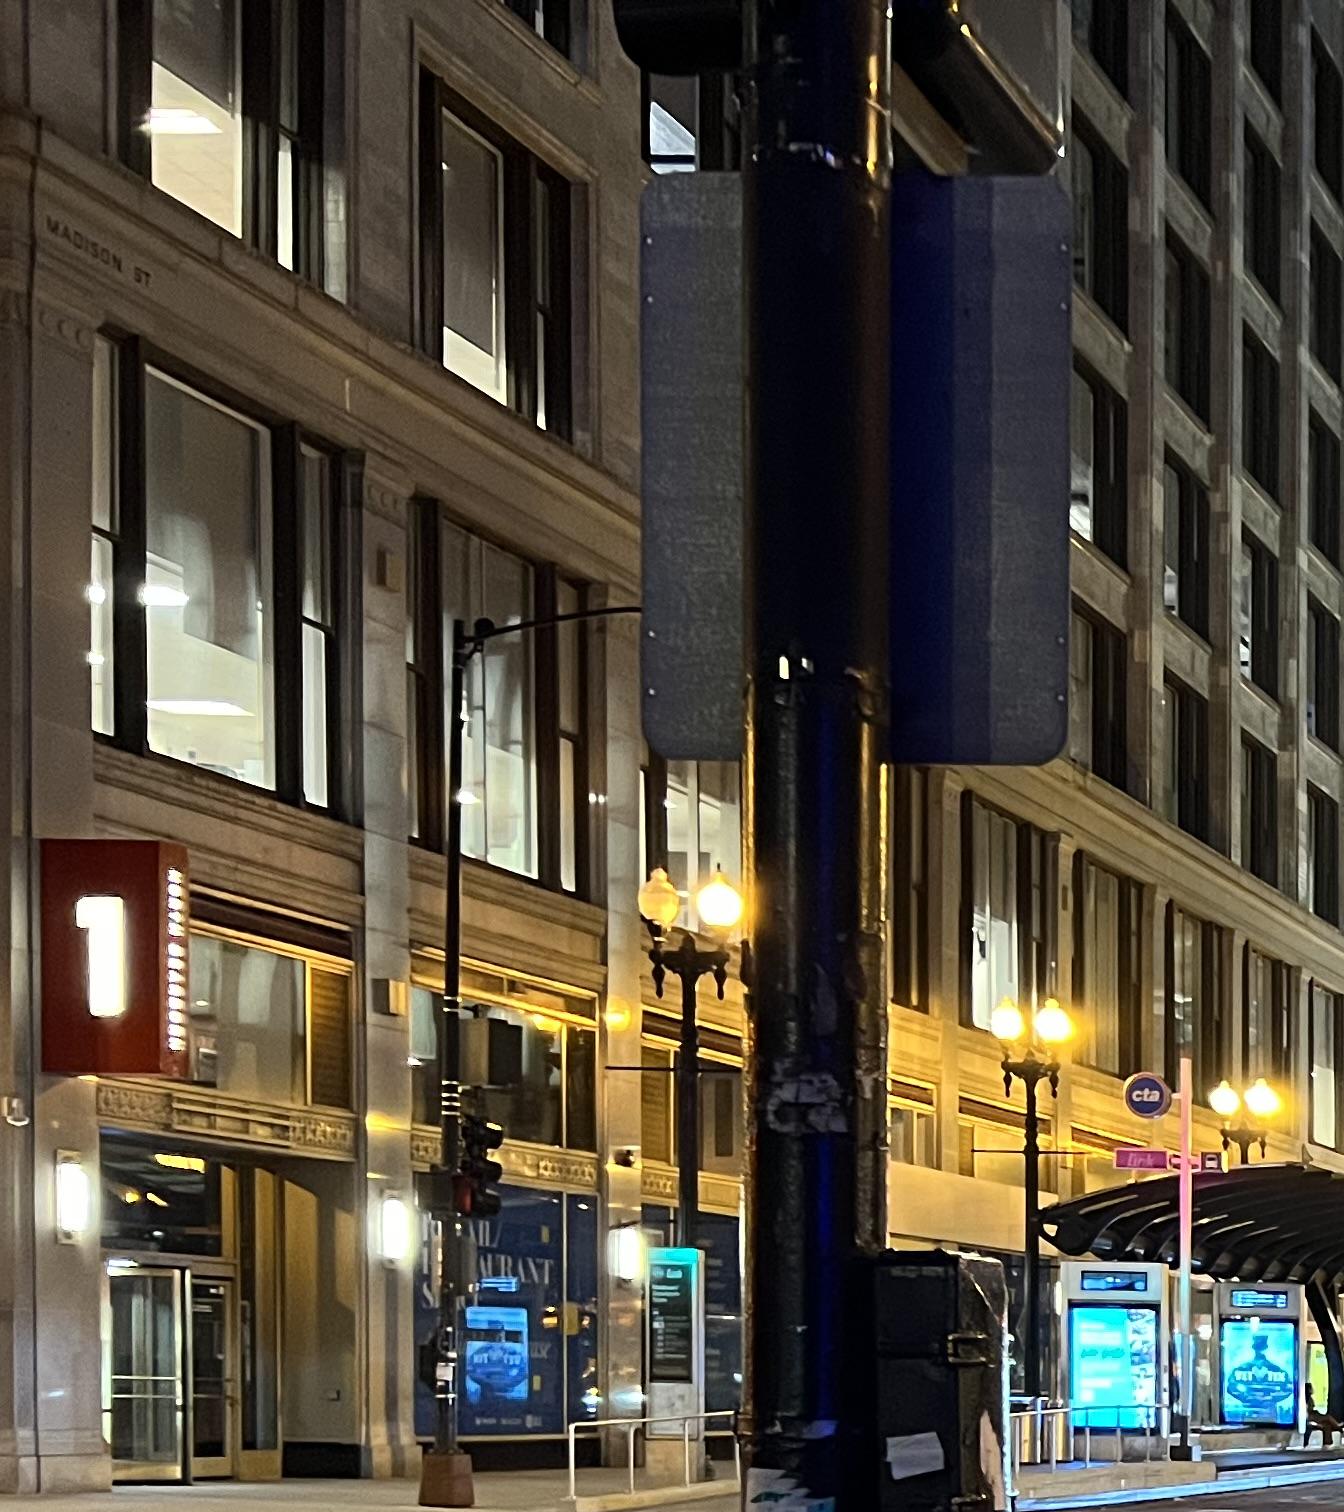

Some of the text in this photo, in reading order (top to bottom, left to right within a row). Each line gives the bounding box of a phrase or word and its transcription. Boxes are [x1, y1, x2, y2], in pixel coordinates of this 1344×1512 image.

[46, 214, 151, 288] MADISON ST
[75, 896, 125, 1017] 1
[1131, 1087, 1161, 1102] cta
